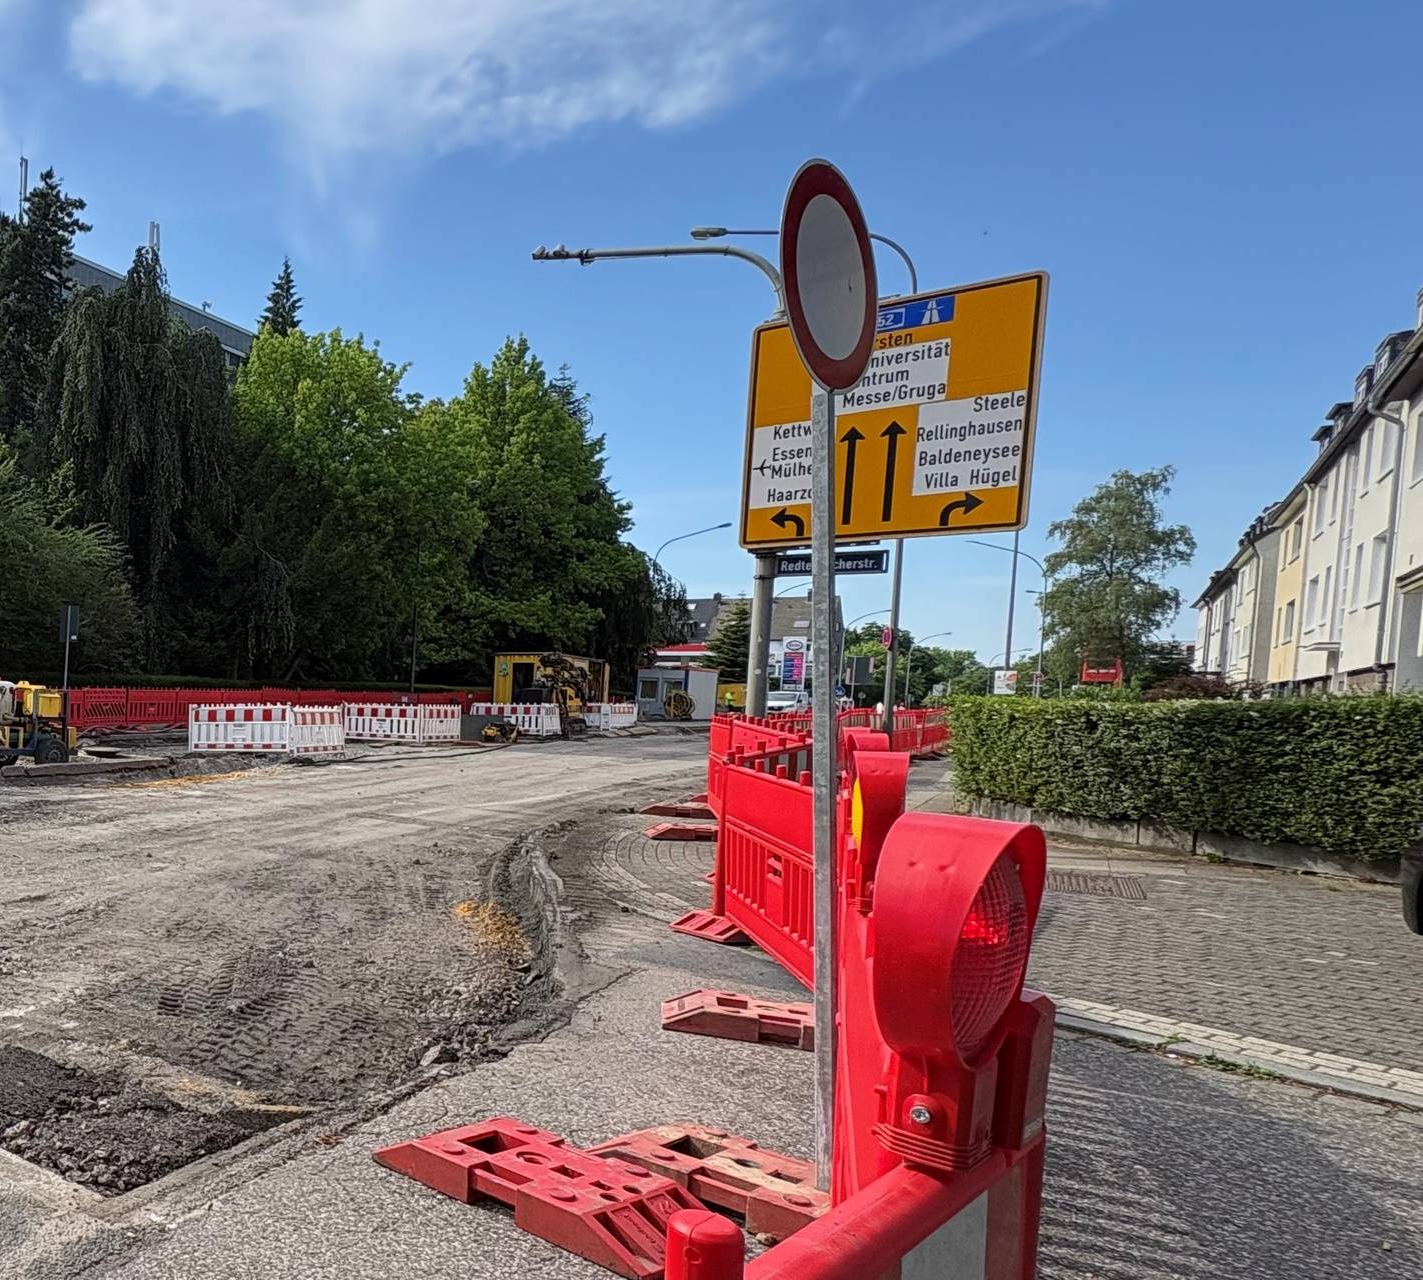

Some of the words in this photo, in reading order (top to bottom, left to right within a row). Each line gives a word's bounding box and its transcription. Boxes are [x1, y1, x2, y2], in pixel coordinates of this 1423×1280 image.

[877, 313, 894, 327] 52
[875, 332, 913, 349] sten
[871, 341, 950, 369] niversität
[858, 369, 910, 388] ntrum
[842, 382, 946, 409] Messe/Gruga
[973, 391, 1026, 413] Steele
[773, 423, 812, 441] Kettw
[916, 418, 1023, 443] Rellinghausen
[772, 446, 812, 462] Essen
[918, 444, 1020, 467] Baldeneysee
[771, 461, 812, 479] Mülhe
[924, 471, 959, 490] Villa
[969, 465, 1017, 488] Hügel
[780, 557, 878, 572] Redtecherstr.
